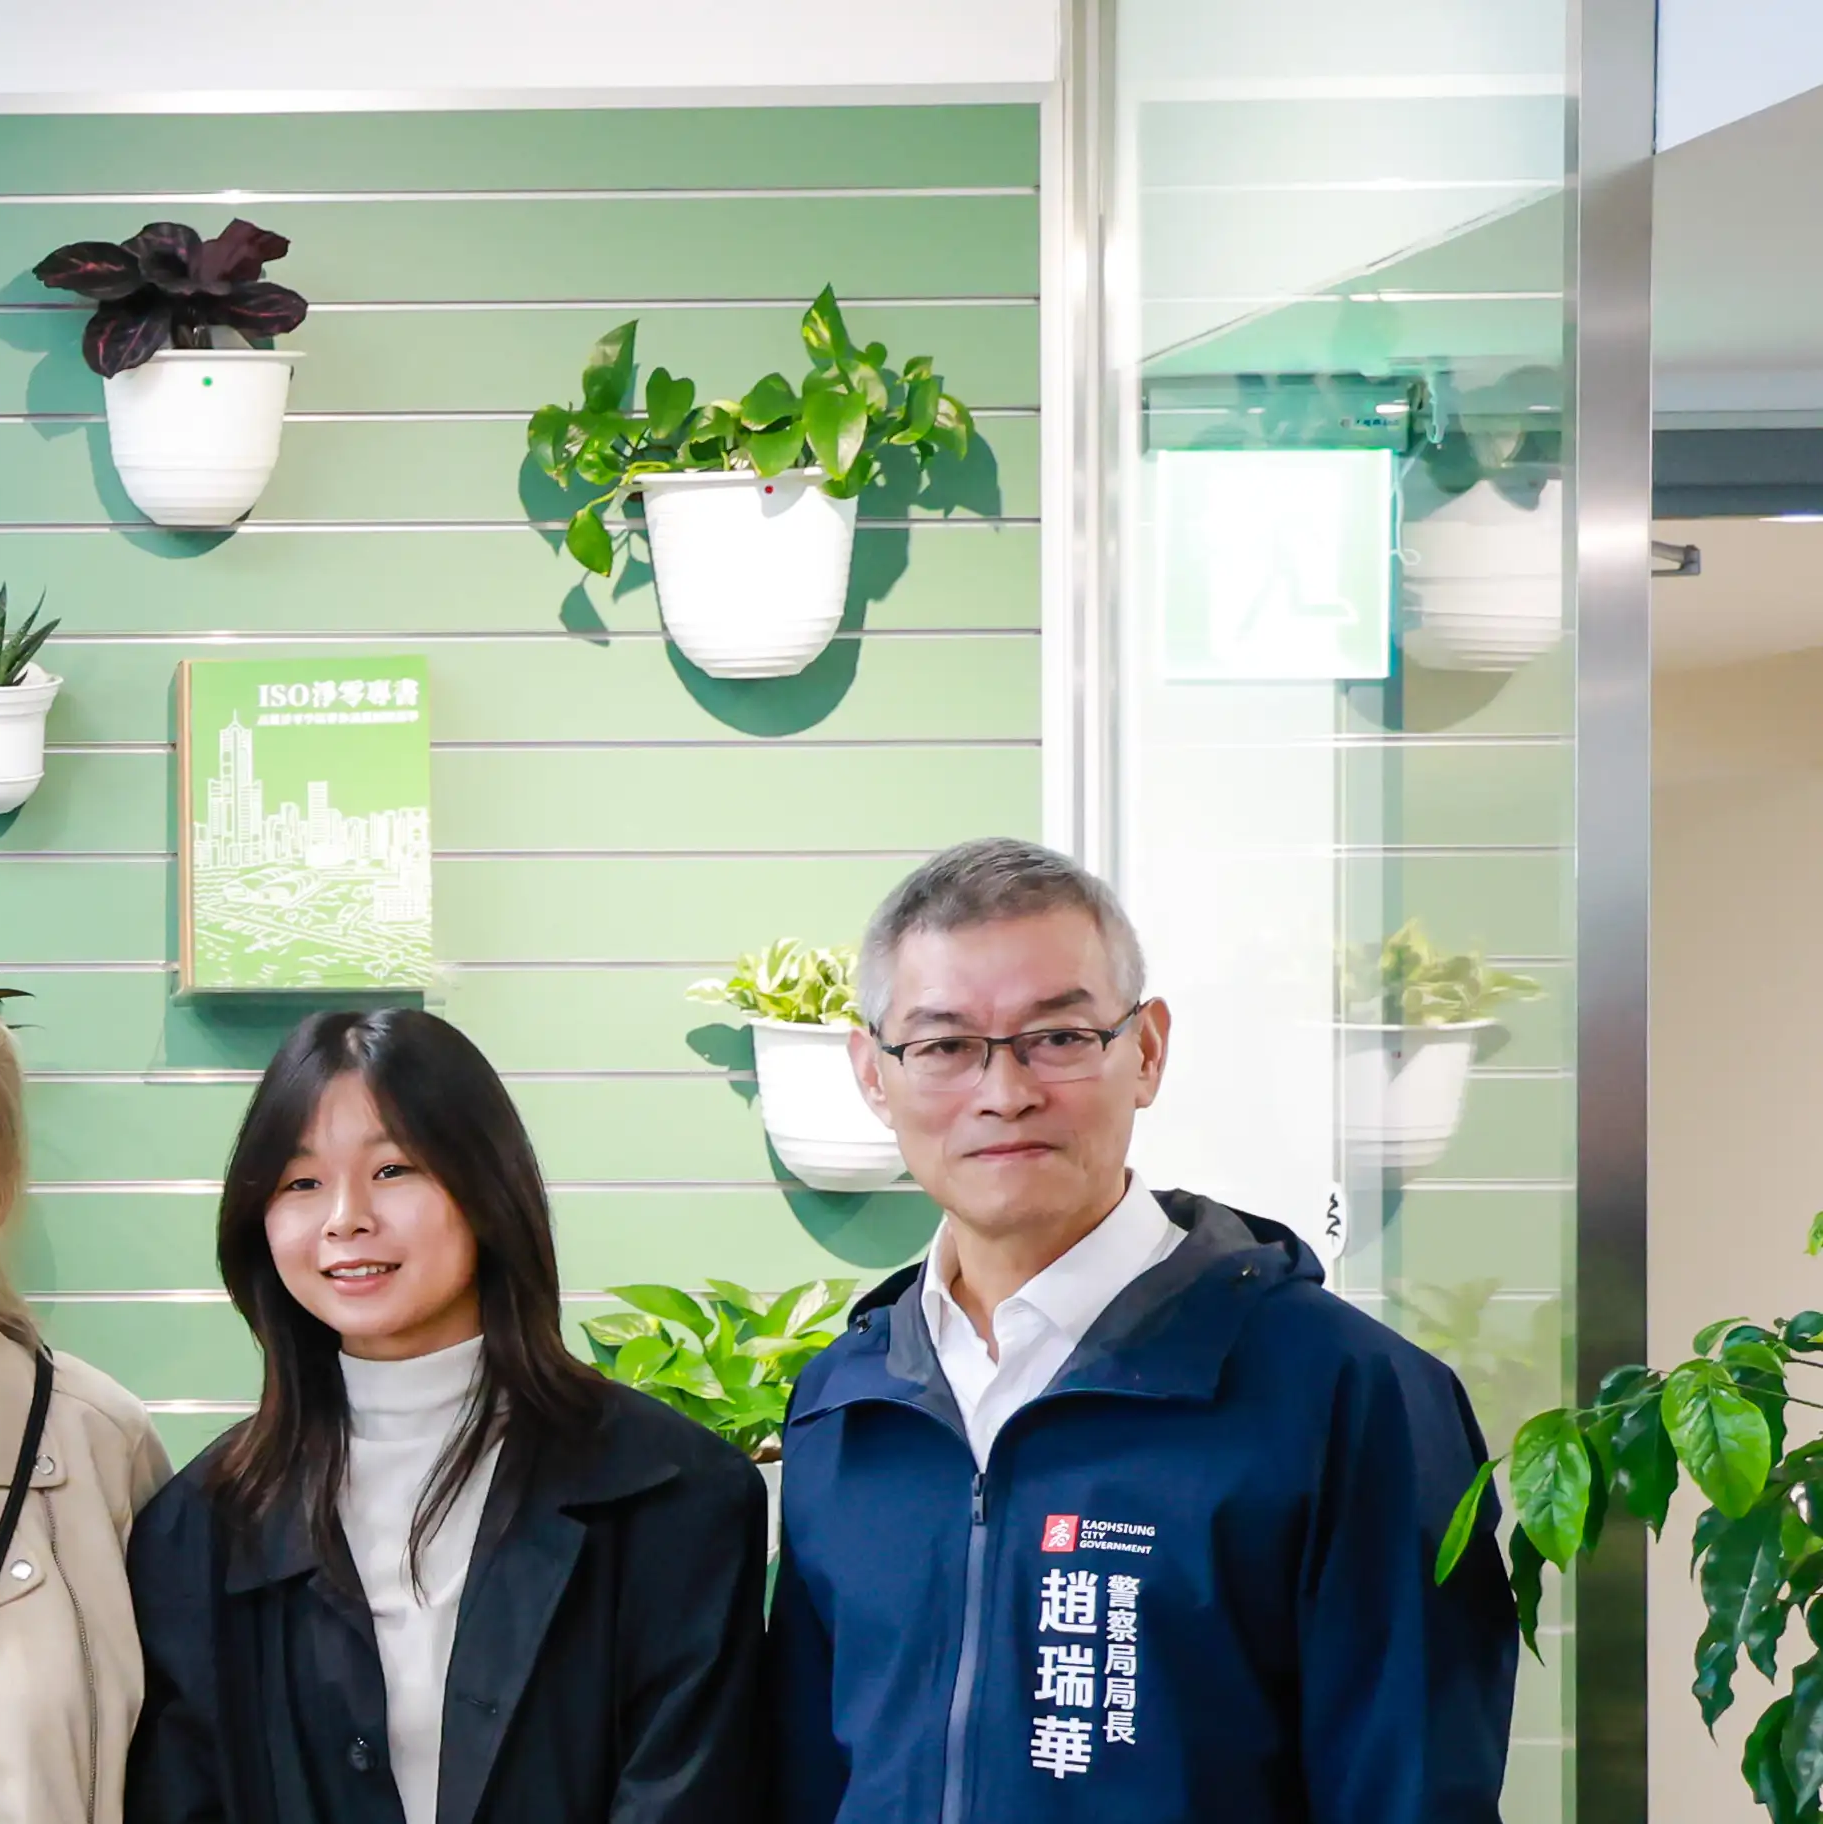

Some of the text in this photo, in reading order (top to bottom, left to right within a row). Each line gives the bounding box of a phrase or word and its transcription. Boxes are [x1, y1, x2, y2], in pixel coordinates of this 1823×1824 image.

[1081, 1519, 1156, 1537] KAOHSIUNG
[1081, 1531, 1106, 1540] CITY
[1079, 1540, 1153, 1555] GOVERNMENT
[1102, 1574, 1140, 1745] 警察局局長
[1030, 1568, 1099, 1779] 趙瑞華
